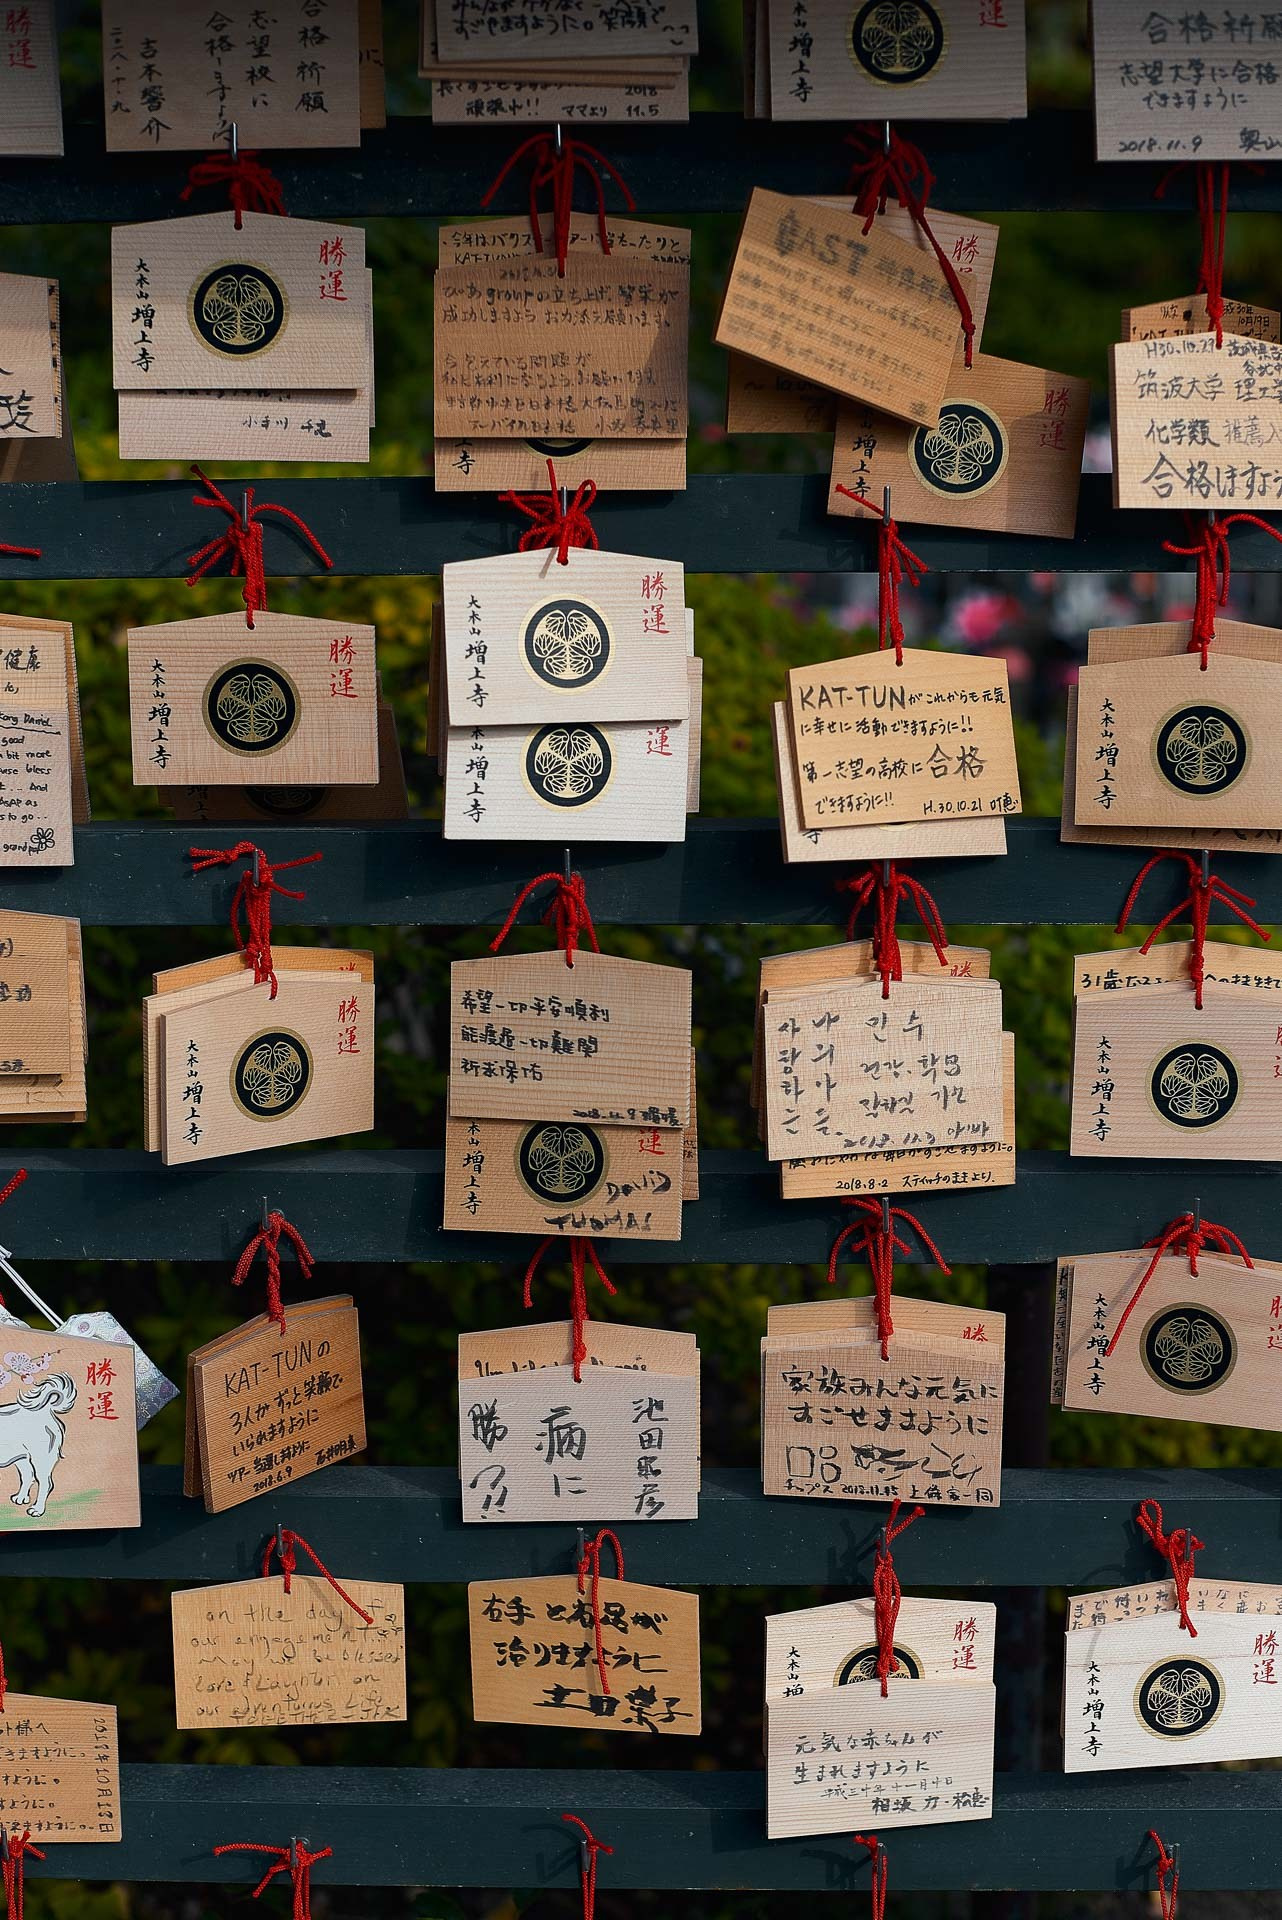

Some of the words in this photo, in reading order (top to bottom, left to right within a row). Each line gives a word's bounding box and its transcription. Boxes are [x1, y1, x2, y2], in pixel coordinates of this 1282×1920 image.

[5, 9, 37, 70] 勝運
[318, 235, 349, 302] 勝運
[130, 257, 156, 374] 大本山増上寺
[1039, 388, 1071, 451] 勝運
[640, 571, 671, 636] 勝運
[328, 634, 359, 700] 勝運
[464, 594, 490, 709] 大本山増上寺
[148, 658, 173, 770] 大本山増上寺
[645, 725, 673, 757] 運
[1093, 697, 1120, 810] 大本山増上寺
[336, 994, 362, 1056] 勝運
[181, 1039, 205, 1146] 大本山増上寺
[1088, 1035, 1116, 1142] 大本山増上寺
[85, 1357, 120, 1421] 勝運
[952, 1616, 980, 1671] 勝運
[1252, 1629, 1281, 1686] 勝運
[1081, 1660, 1106, 1758] 大本山増上寺
